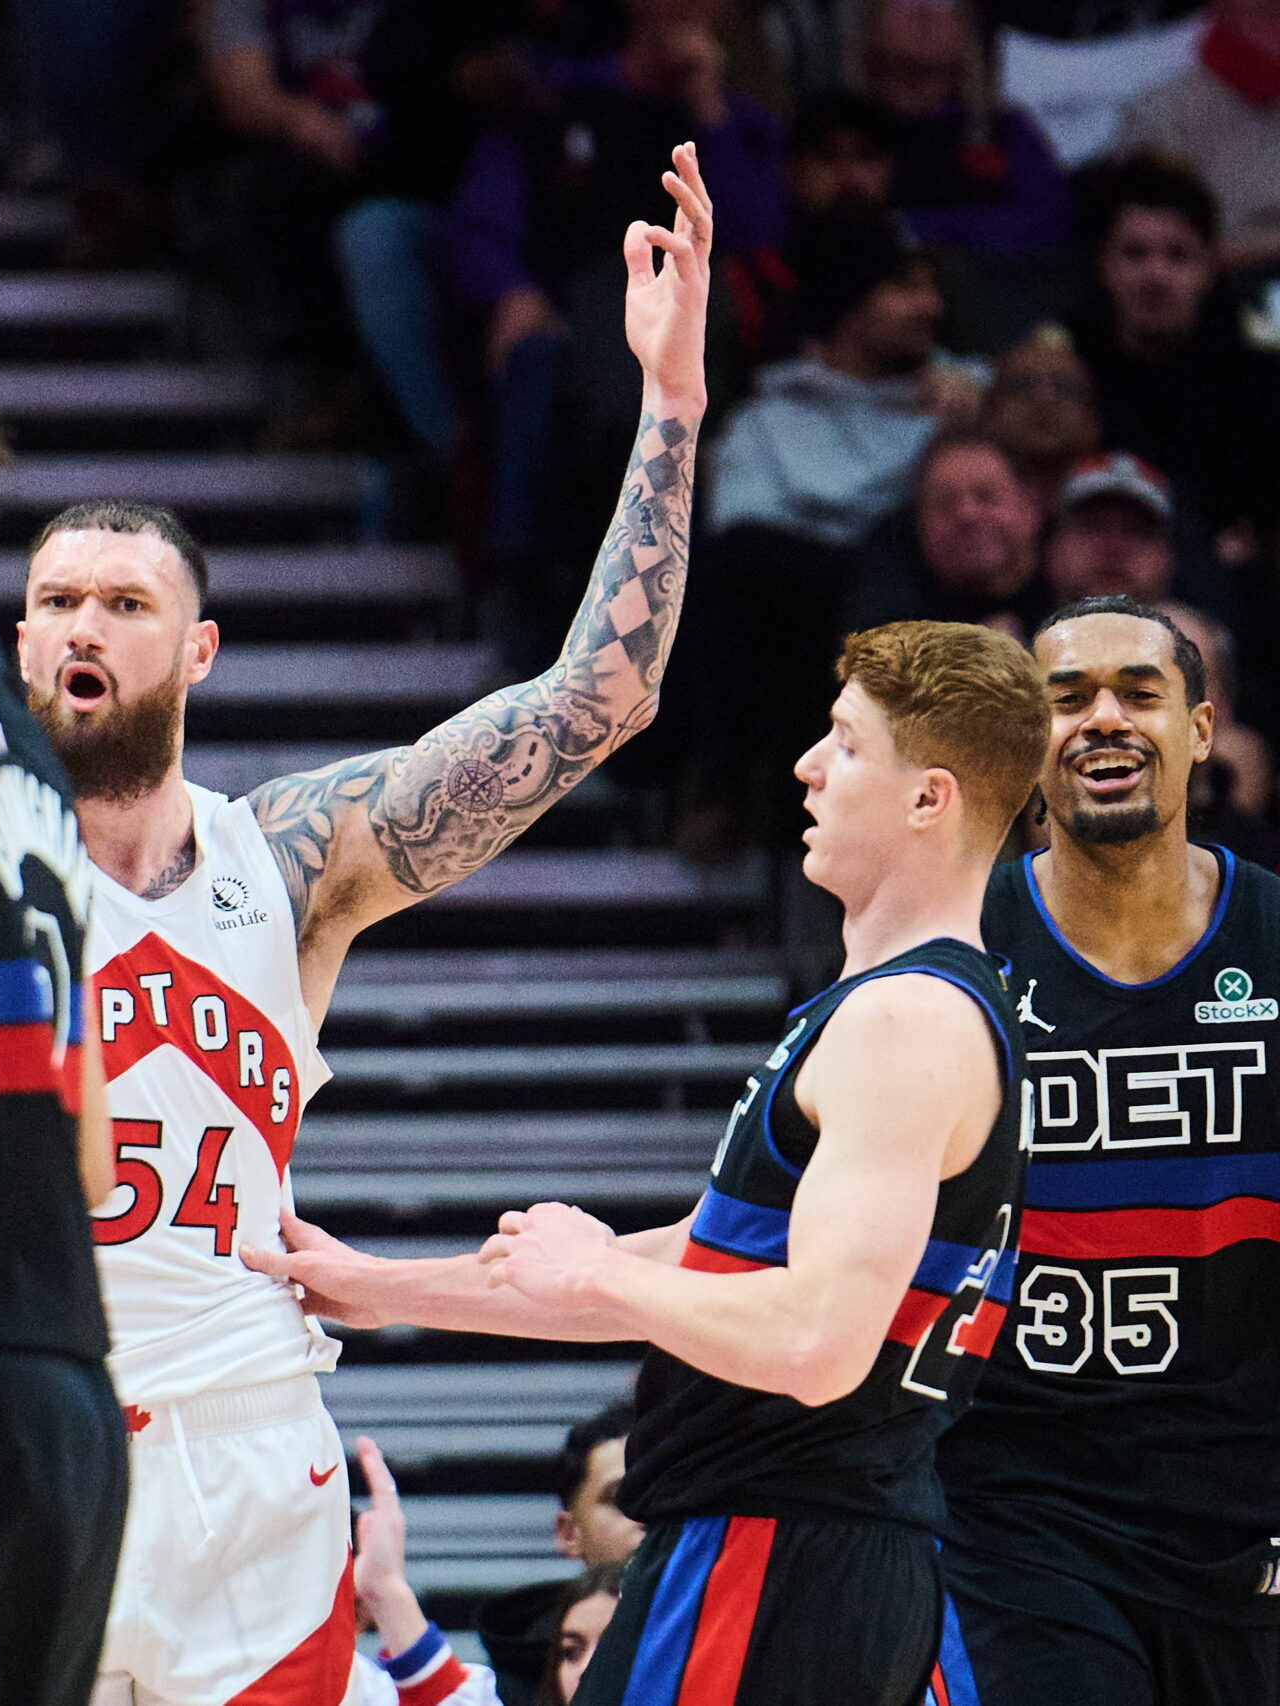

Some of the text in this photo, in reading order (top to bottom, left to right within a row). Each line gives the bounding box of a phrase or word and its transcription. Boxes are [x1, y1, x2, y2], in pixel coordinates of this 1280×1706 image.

[239, 908, 269, 926] Life
[100, 971, 291, 1125] PTORS
[1198, 1002, 1275, 1021] StockX
[1025, 1041, 1266, 1152] DET
[91, 1117, 240, 1258] 54
[1015, 1265, 1180, 1376] 35
